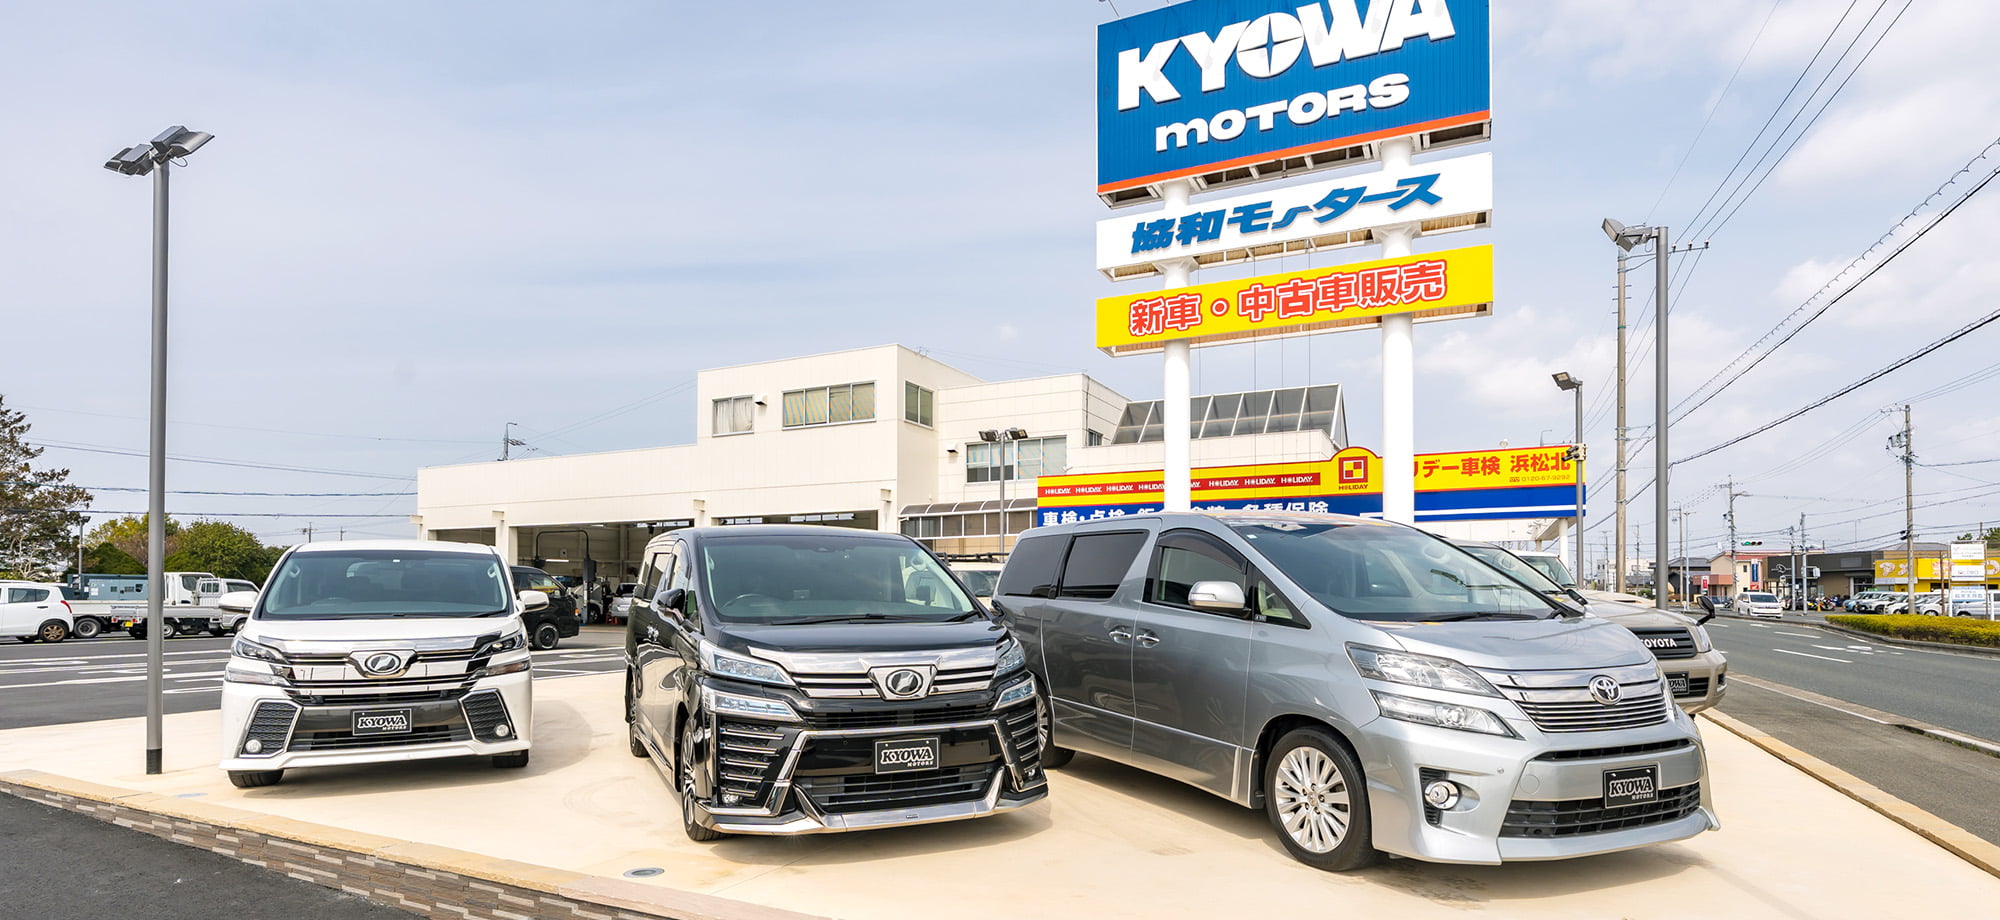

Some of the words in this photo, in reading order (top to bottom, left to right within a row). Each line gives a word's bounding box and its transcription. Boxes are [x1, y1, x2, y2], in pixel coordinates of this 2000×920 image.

[1118, 0, 1455, 111] KYOWA
[1131, 173, 1443, 254] 協和モータース
[1130, 260, 1446, 335] 新車・中古車販売
[1510, 452, 1571, 472] 浜松北
[1641, 638, 1677, 648] OYOTA
[357, 715, 407, 728] KYOWA
[880, 746, 934, 764] KYOWA
[1609, 776, 1654, 797] KYOWA
